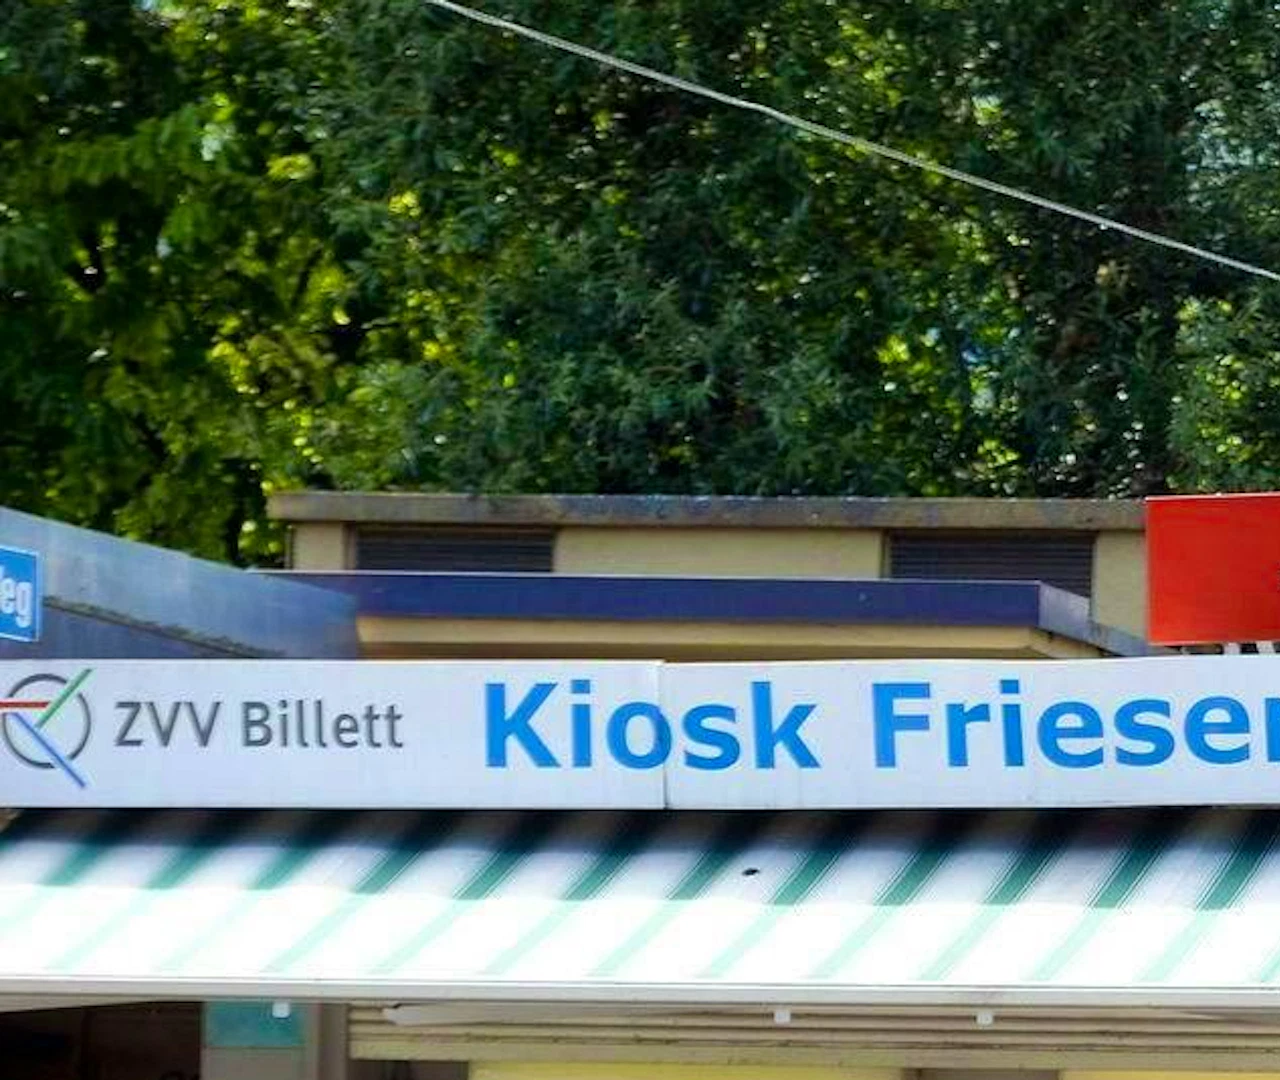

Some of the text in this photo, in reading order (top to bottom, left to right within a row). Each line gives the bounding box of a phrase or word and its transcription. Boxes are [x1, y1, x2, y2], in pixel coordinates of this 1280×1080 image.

[0, 563, 33, 629] eg
[114, 699, 404, 749] ZVV Billett
[484, 678, 822, 771] Kiosk
